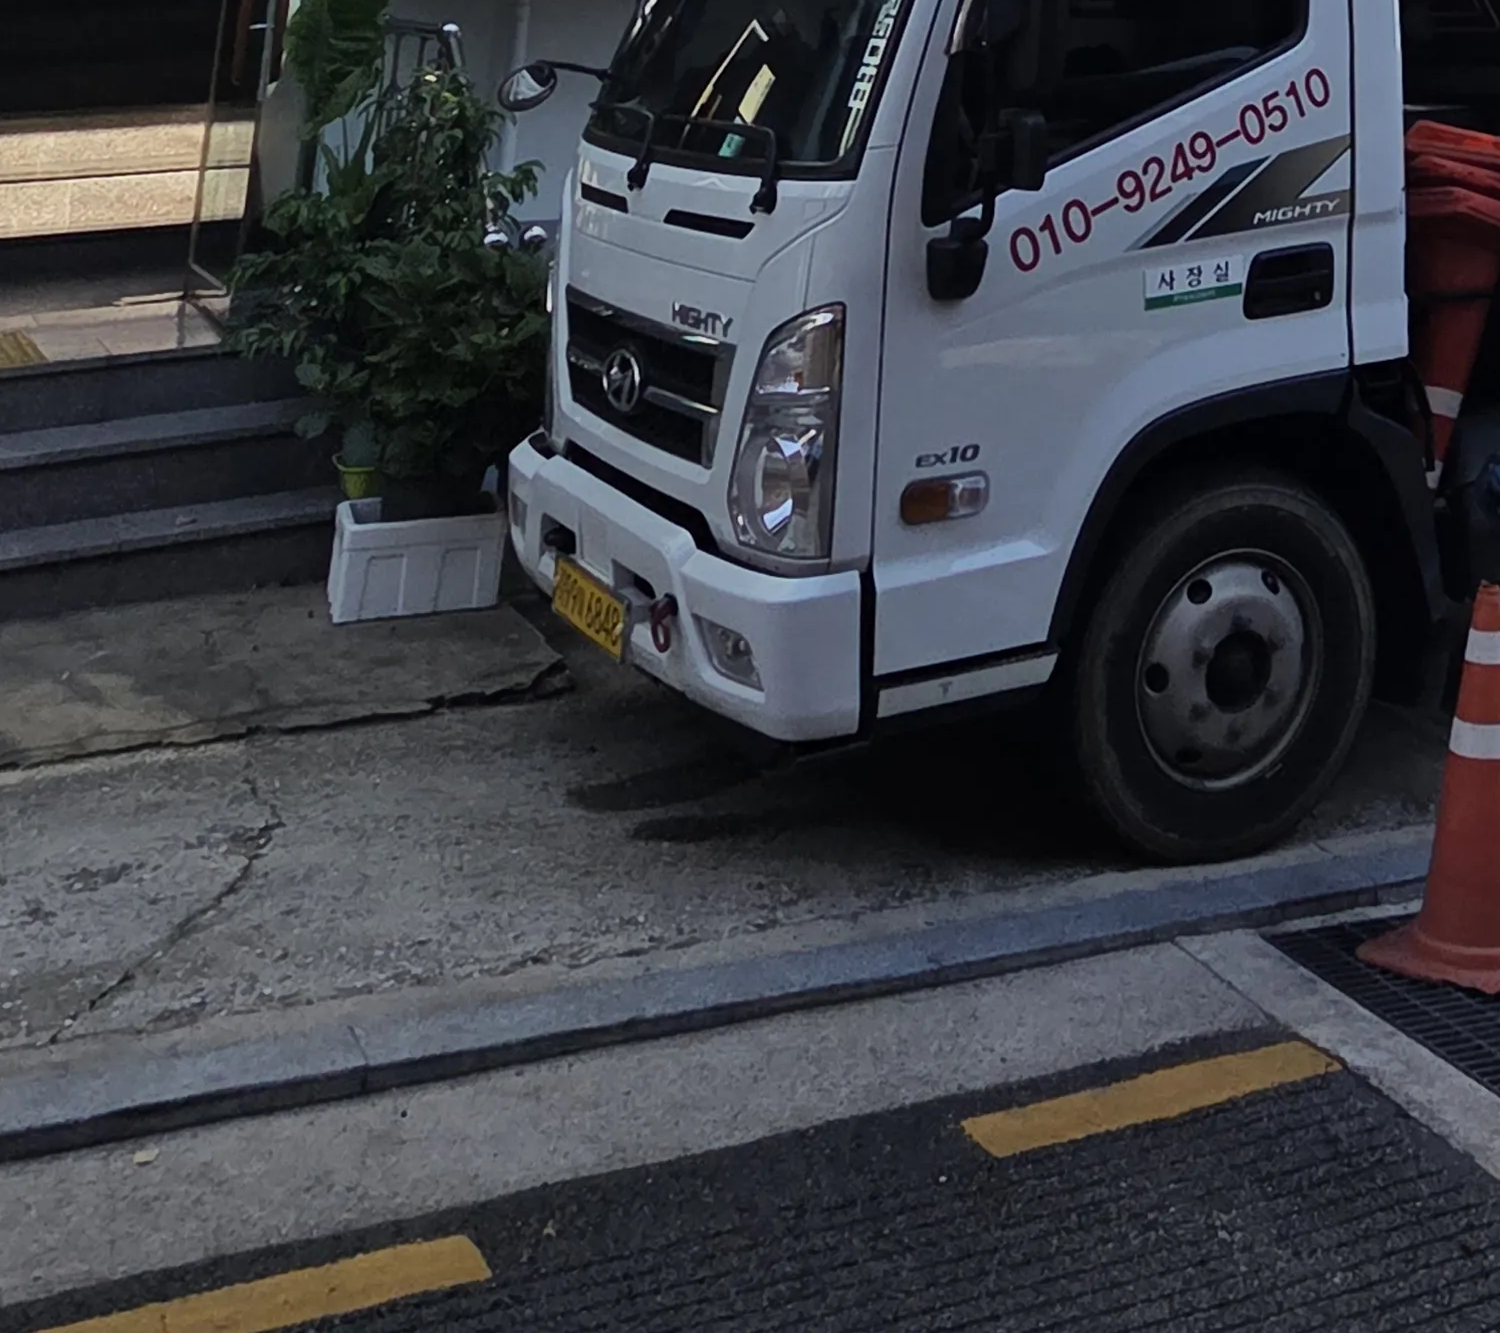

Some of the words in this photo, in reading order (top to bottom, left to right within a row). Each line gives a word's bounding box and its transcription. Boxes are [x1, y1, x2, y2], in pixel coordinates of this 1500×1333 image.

[1009, 68, 1331, 273] 010-9249-0510
[1252, 198, 1342, 225] MIGHTY
[671, 300, 734, 338] MIGHTY
[915, 443, 981, 469] EX10
